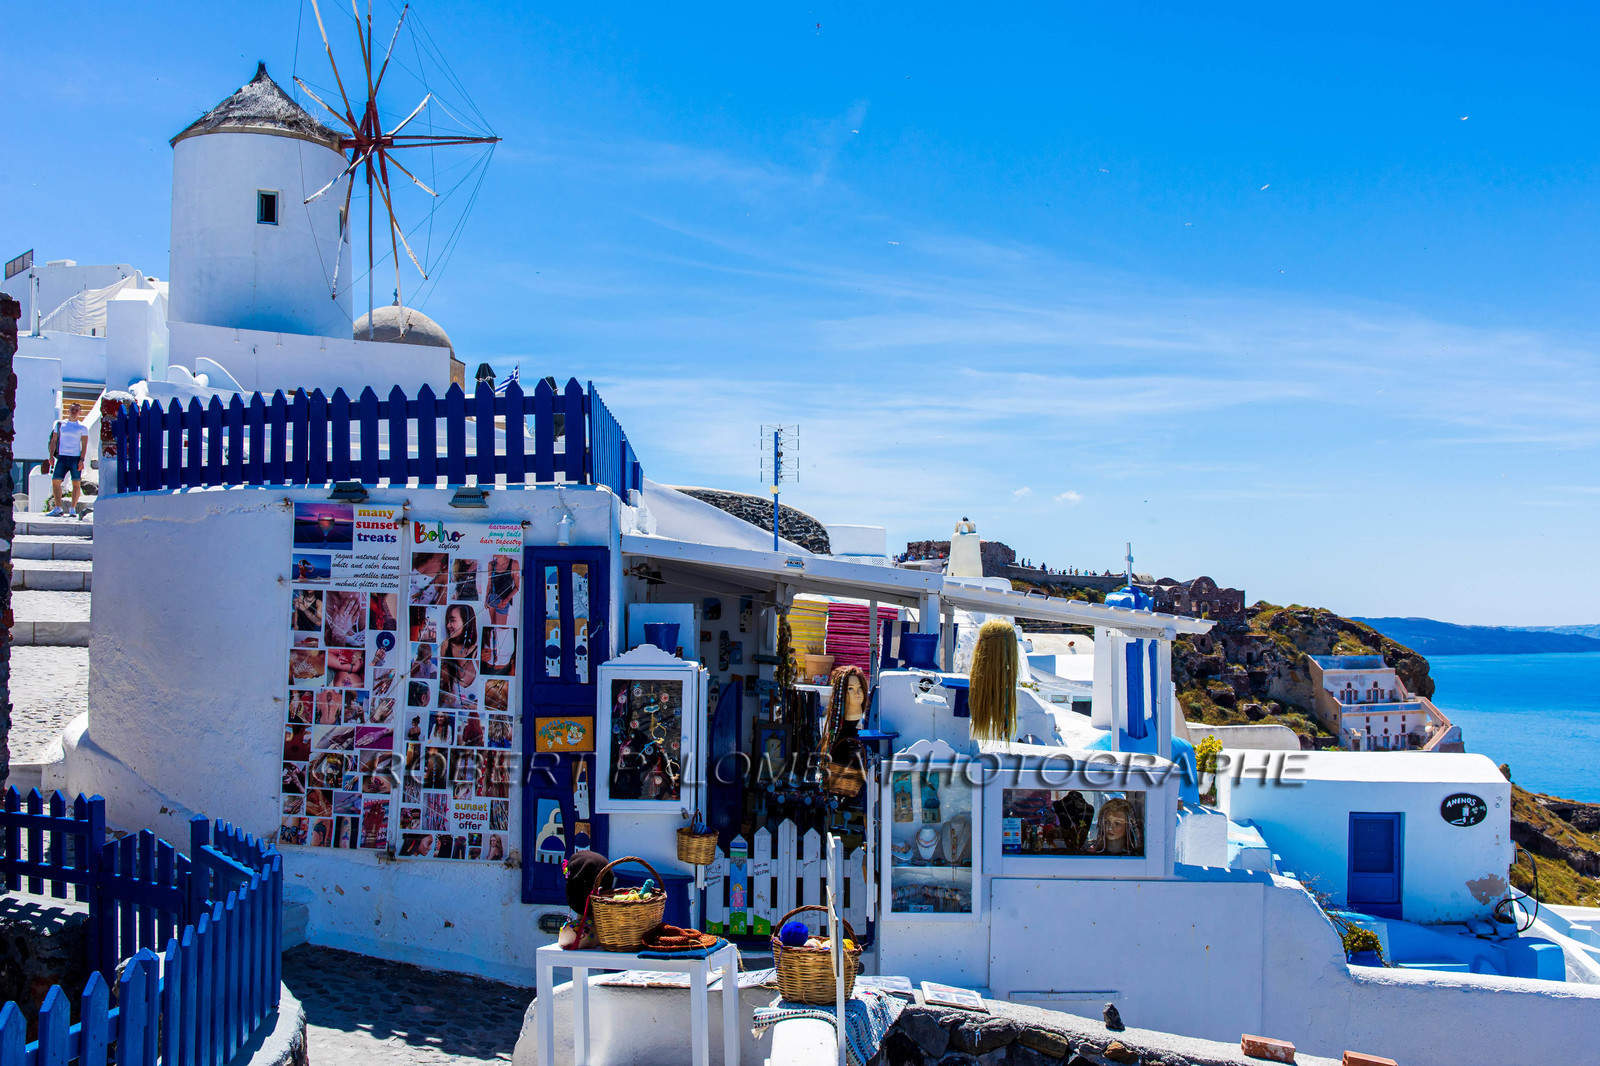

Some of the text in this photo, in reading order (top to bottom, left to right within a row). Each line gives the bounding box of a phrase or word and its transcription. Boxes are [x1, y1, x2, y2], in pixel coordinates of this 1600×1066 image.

[358, 509, 395, 520] many
[355, 521, 399, 530] sunset
[488, 523, 522, 531] hairwraps
[414, 520, 466, 544] Boho
[357, 532, 397, 543] treats
[495, 537, 523, 546] tapestry
[438, 542, 460, 551] styling
[498, 545, 521, 553] dreads
[334, 552, 400, 561] jagua natural henna
[331, 560, 349, 569] white
[364, 562, 380, 570] color
[382, 562, 400, 570] henna
[353, 571, 399, 580] metallic tattoo
[334, 579, 399, 589] mehndi glitter tattoo
[454, 802, 488, 812] sunset
[453, 811, 488, 821] special
[458, 820, 482, 830] offer
